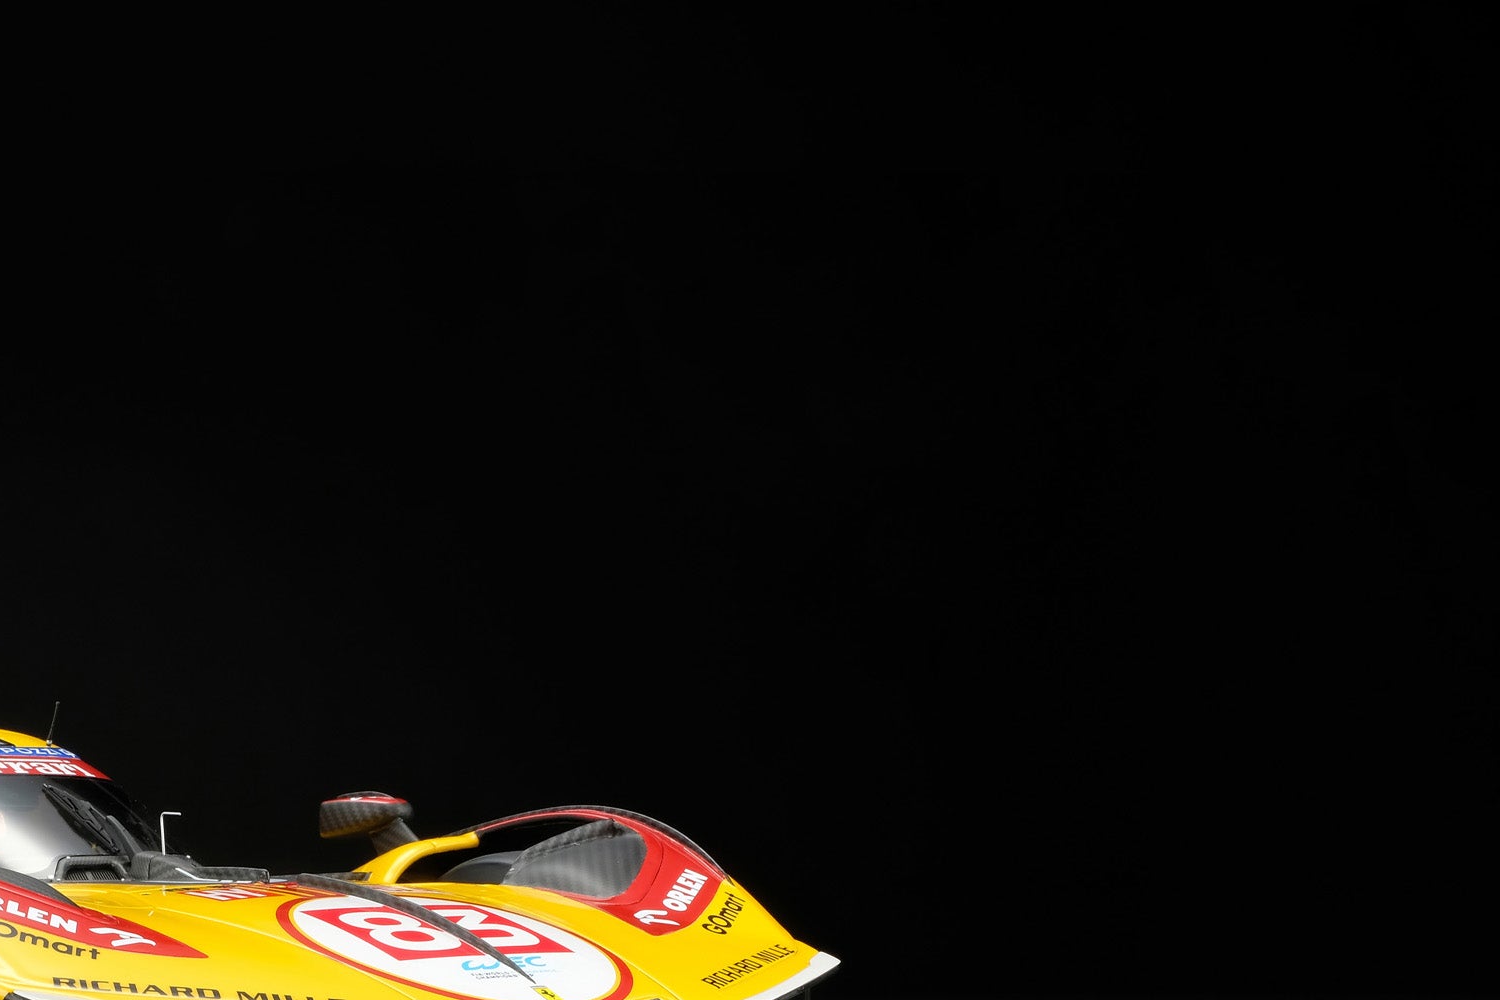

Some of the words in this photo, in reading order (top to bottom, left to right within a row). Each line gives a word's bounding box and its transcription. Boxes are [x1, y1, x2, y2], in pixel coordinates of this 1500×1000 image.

[662, 868, 708, 912] ORLEN
[338, 909, 541, 951] 83
[701, 891, 746, 935] GOmart
[52, 976, 221, 999] RICHARD
[701, 959, 764, 990] RICHARD
[751, 944, 795, 965] MILLE
